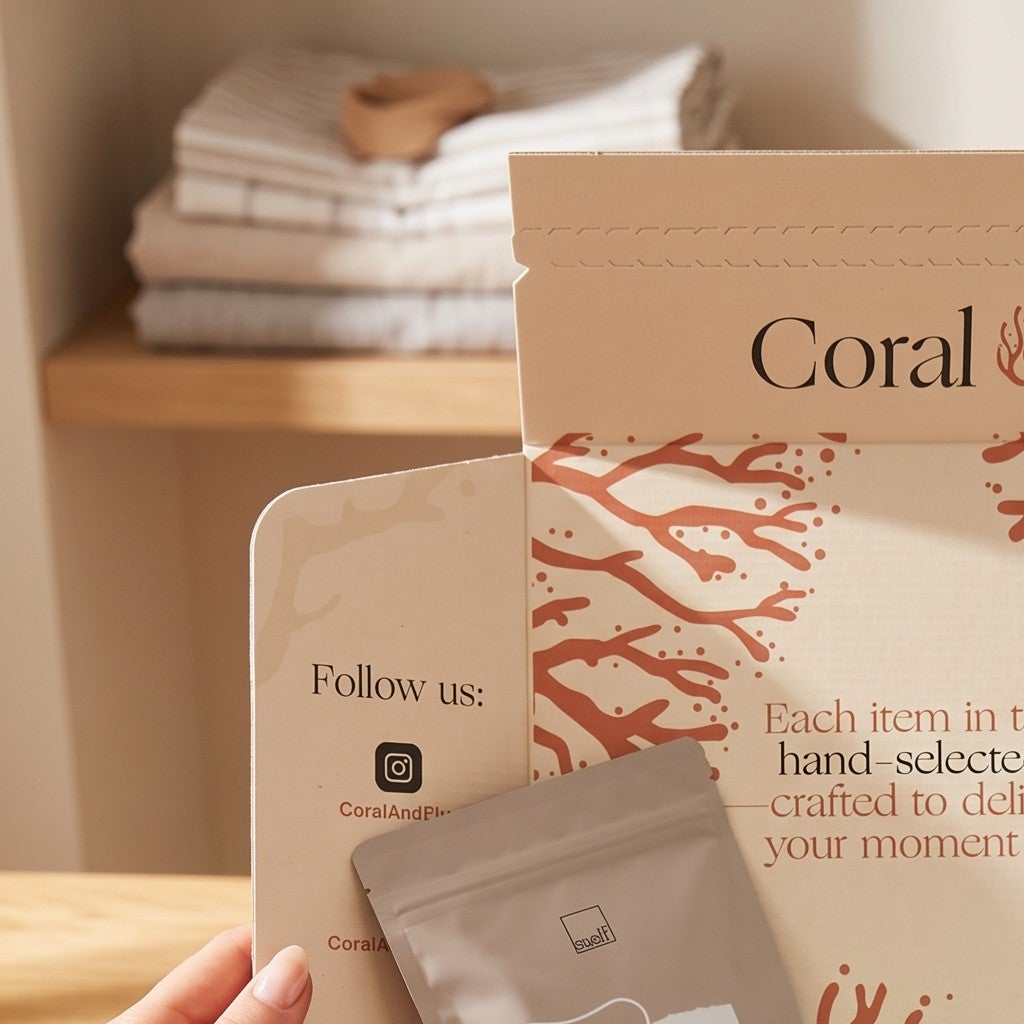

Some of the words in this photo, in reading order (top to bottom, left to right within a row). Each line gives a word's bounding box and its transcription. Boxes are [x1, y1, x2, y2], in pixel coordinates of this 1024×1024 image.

[752, 306, 976, 390] Coral
[311, 663, 428, 702] Follow
[438, 681, 483, 707] us:
[764, 698, 857, 734] Each
[870, 702, 951, 733] item
[964, 701, 997, 732] in
[911, 790, 948, 817] to
[763, 835, 848, 868] your
[861, 831, 1019, 859] moment
